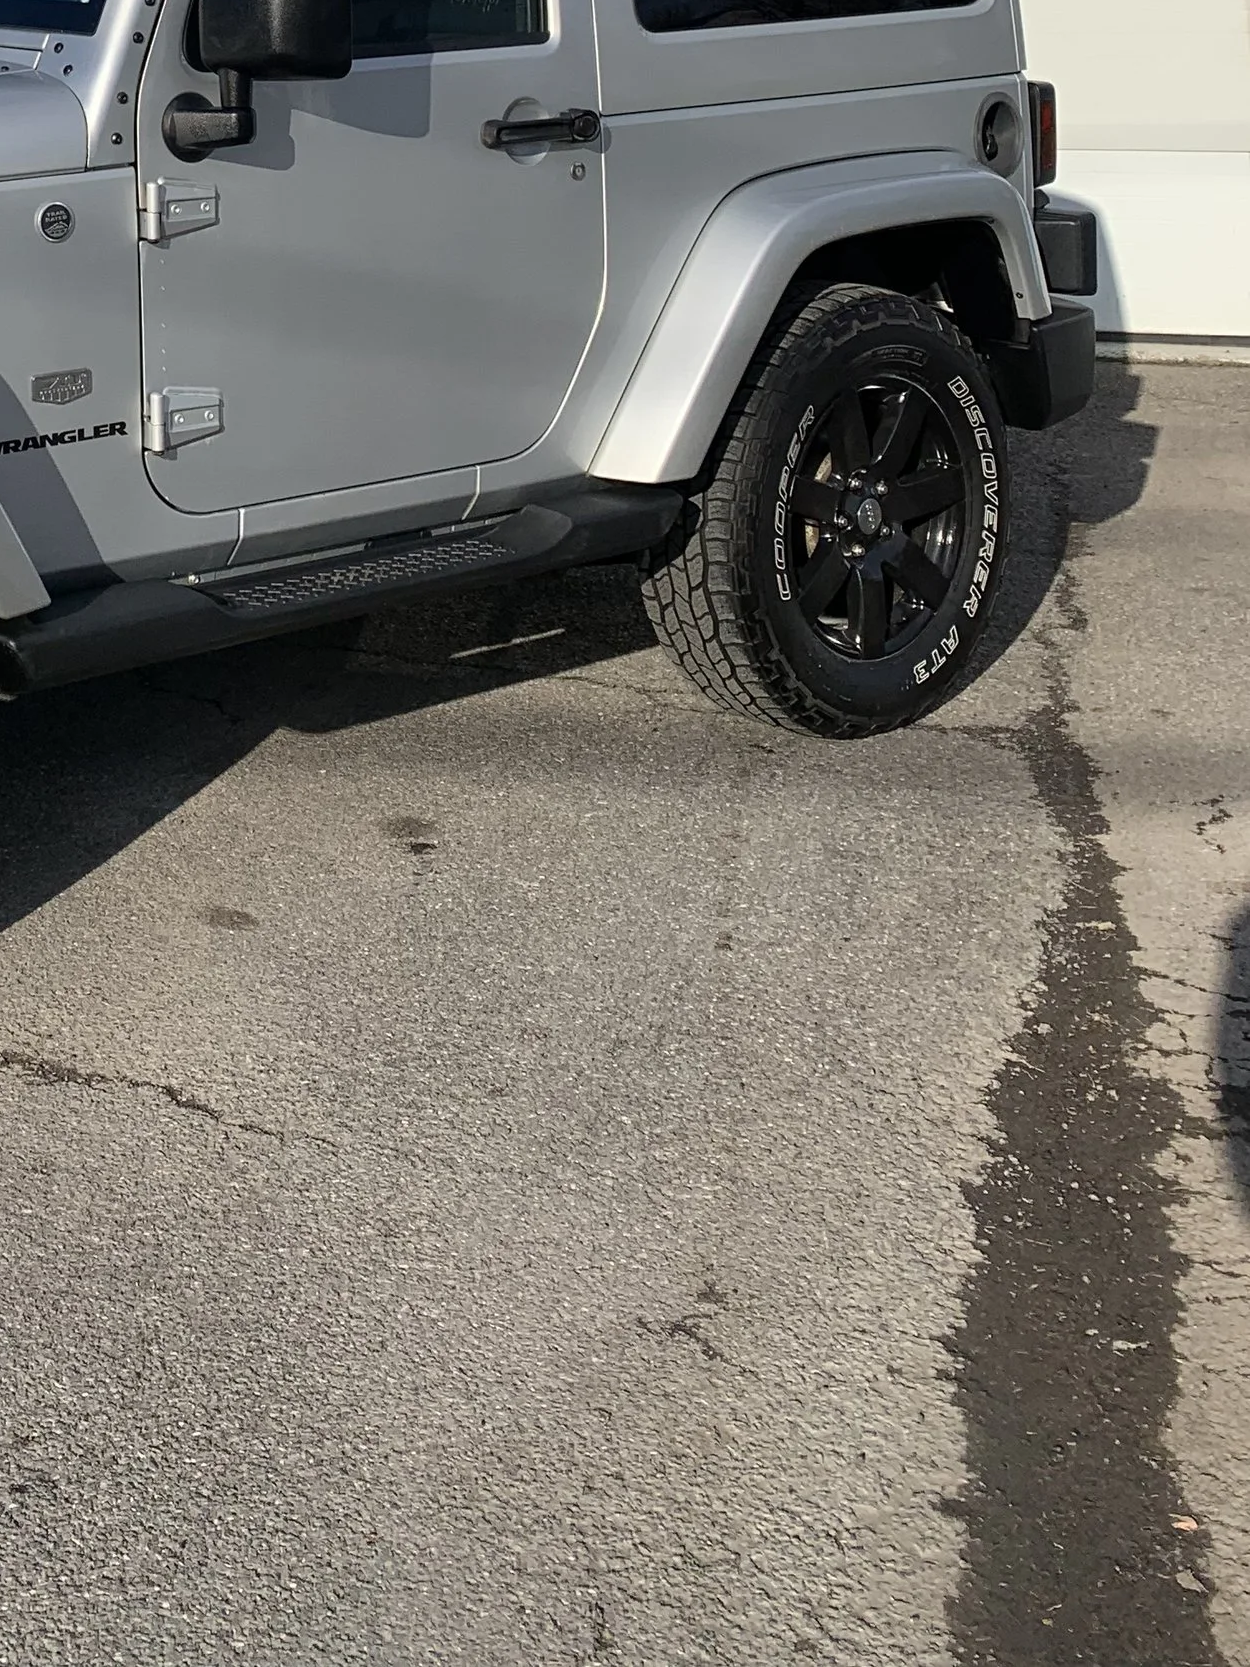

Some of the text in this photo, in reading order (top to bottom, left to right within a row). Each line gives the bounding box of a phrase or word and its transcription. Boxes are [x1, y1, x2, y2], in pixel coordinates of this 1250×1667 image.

[772, 405, 815, 601] COOPER
[914, 376, 999, 684] DISCOVERER AT3
